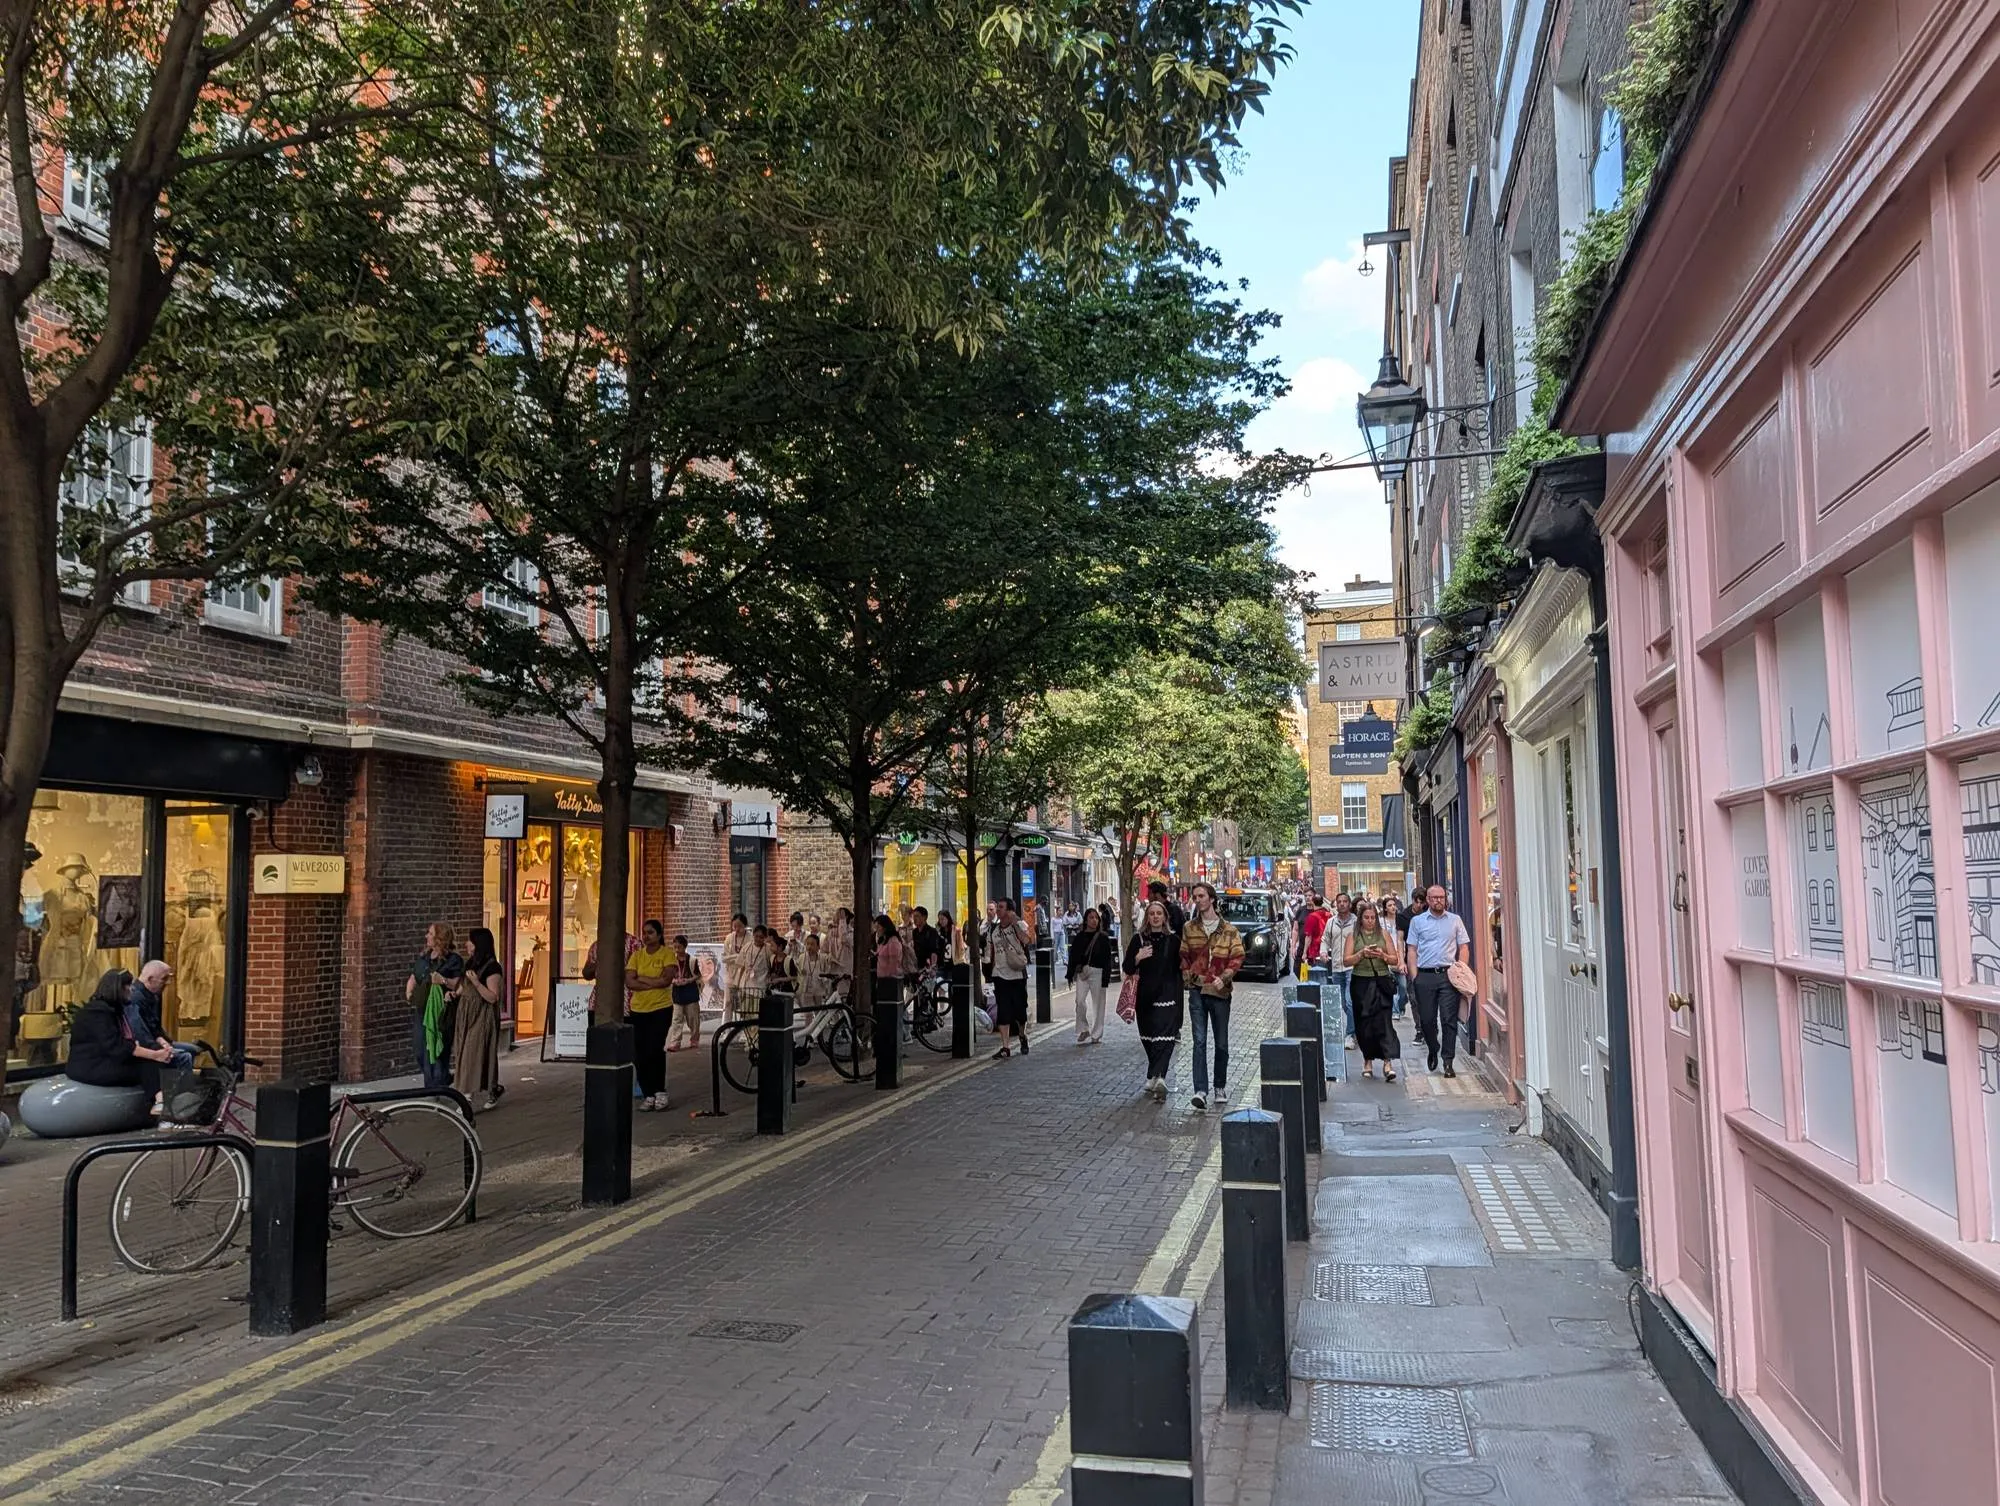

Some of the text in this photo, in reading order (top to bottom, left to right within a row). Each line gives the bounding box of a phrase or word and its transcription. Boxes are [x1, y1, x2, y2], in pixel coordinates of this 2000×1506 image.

[1328, 654, 1397, 670] ASTRID
[1328, 671, 1398, 688] & MIYU
[1348, 732, 1391, 743] HORACE
[554, 789, 583, 818] Tatty
[489, 808, 508, 820] Tatty
[1018, 836, 1046, 846] schuh
[1383, 843, 1405, 858] alo
[292, 861, 341, 874] WEVE2050
[1744, 855, 1769, 874] COVEN
[1744, 879, 1771, 898] GARDE
